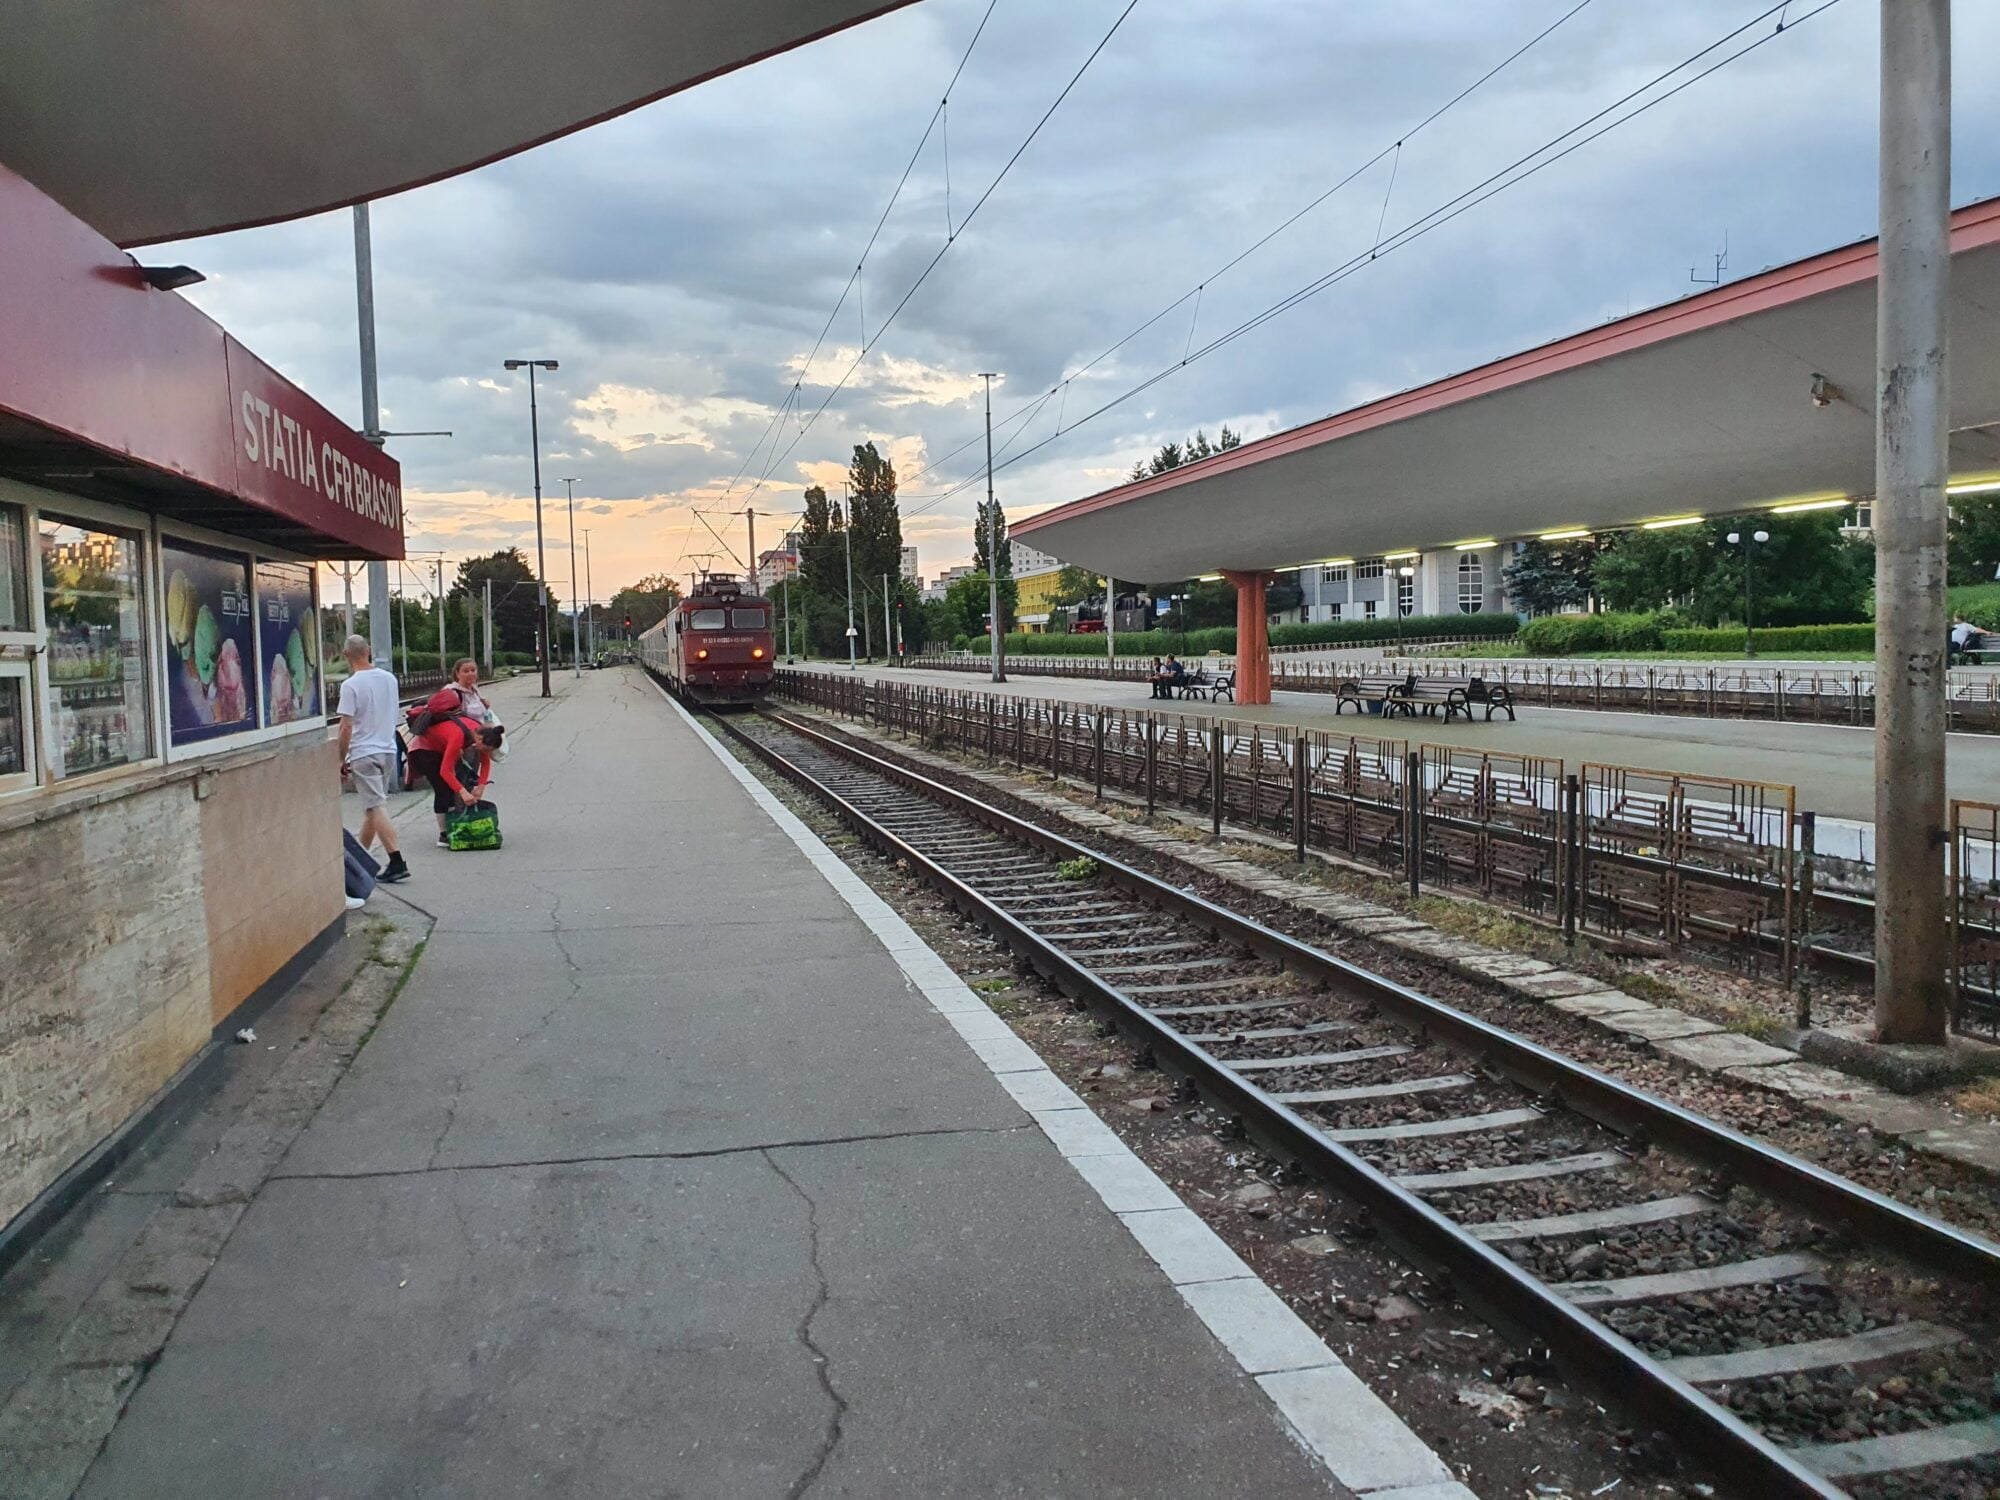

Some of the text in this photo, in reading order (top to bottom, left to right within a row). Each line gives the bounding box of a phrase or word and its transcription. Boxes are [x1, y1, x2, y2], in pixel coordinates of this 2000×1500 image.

[242, 390, 400, 531] STATIA CFR BRASOV
